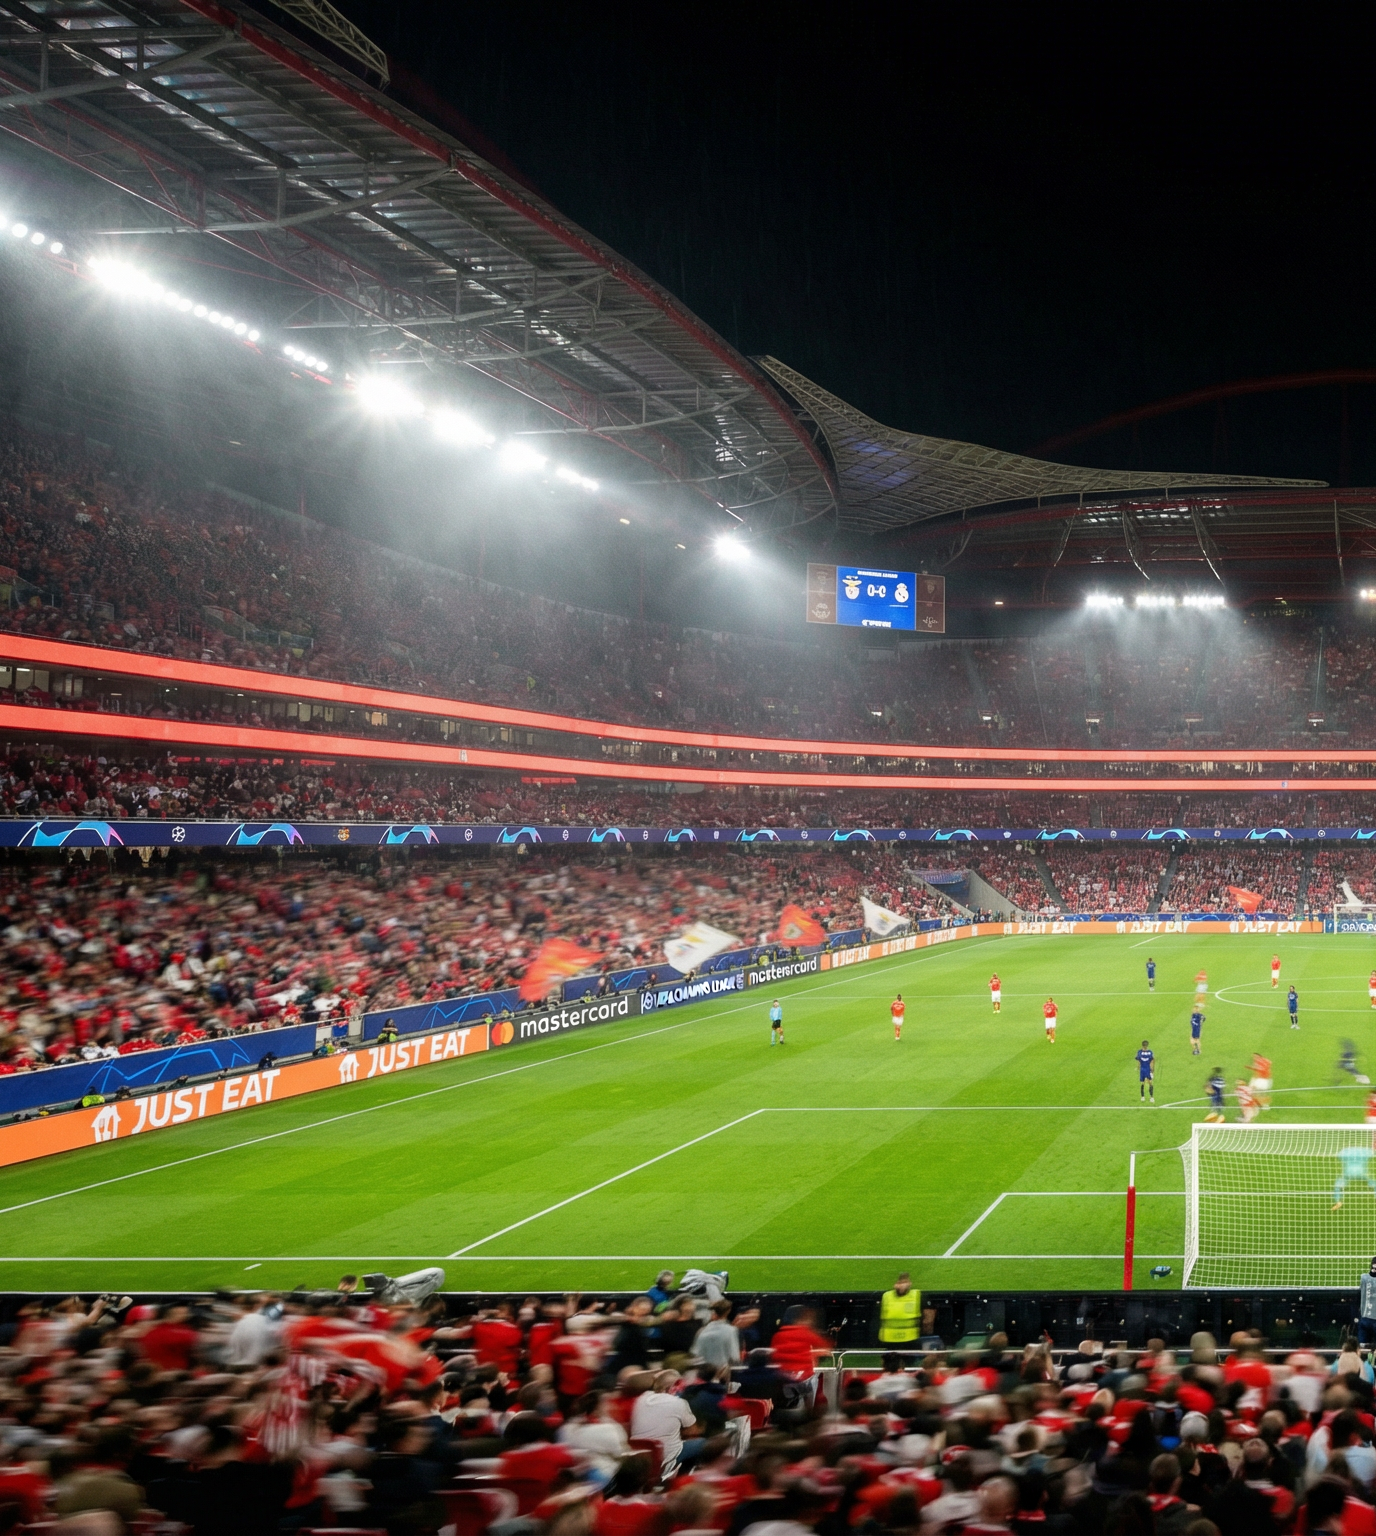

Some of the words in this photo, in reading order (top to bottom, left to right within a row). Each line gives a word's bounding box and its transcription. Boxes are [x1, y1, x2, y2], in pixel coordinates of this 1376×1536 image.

[520, 996, 629, 1039] mastercard
[367, 1038, 426, 1079] JUST
[430, 1028, 471, 1063] EAT
[131, 1082, 215, 1135] JUST
[222, 1068, 281, 1112] EAT
